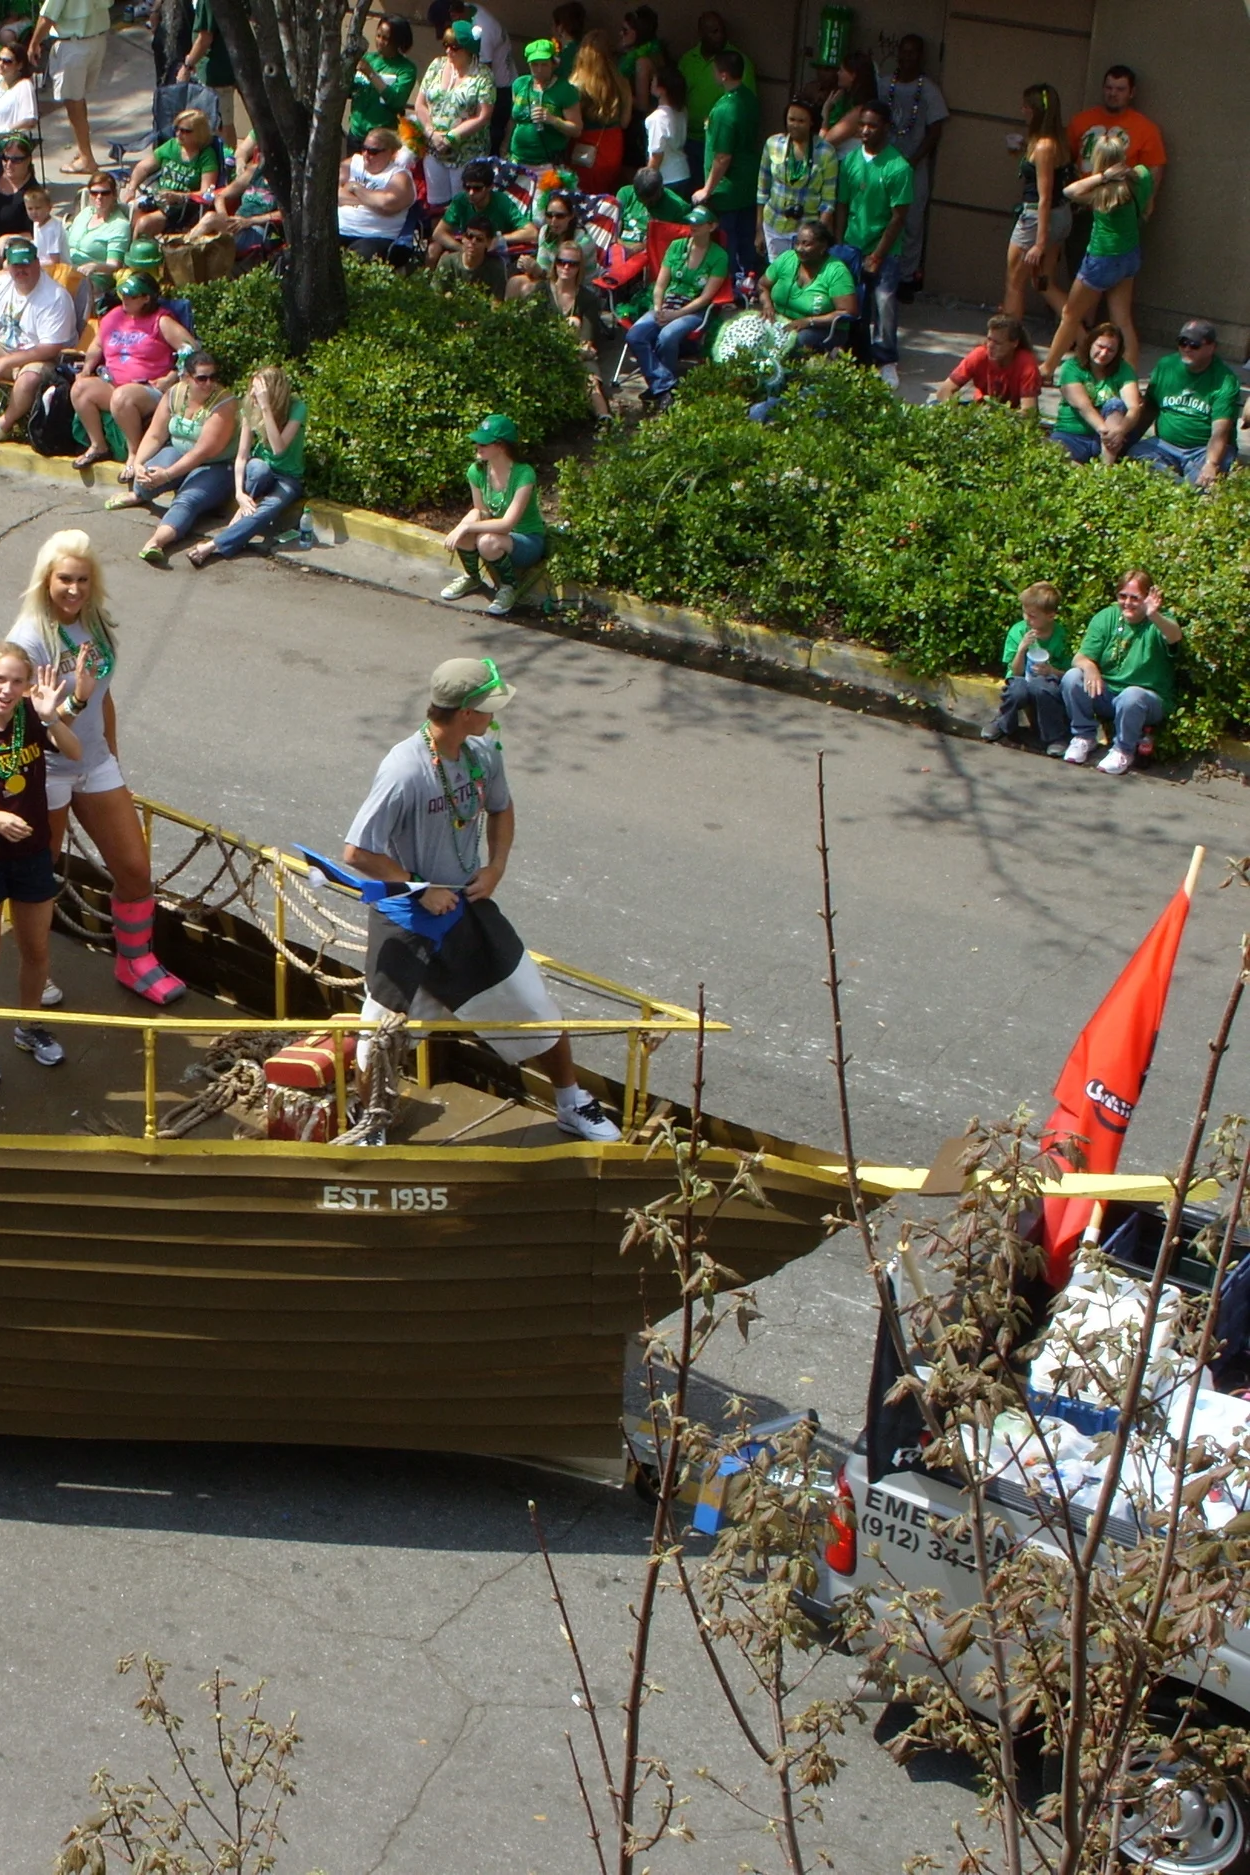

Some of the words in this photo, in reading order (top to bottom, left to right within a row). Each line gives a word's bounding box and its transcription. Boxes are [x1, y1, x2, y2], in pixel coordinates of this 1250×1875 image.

[323, 1185, 380, 1210] EST.
[390, 1187, 449, 1211] 1935
[861, 1513, 920, 1553] (912)
